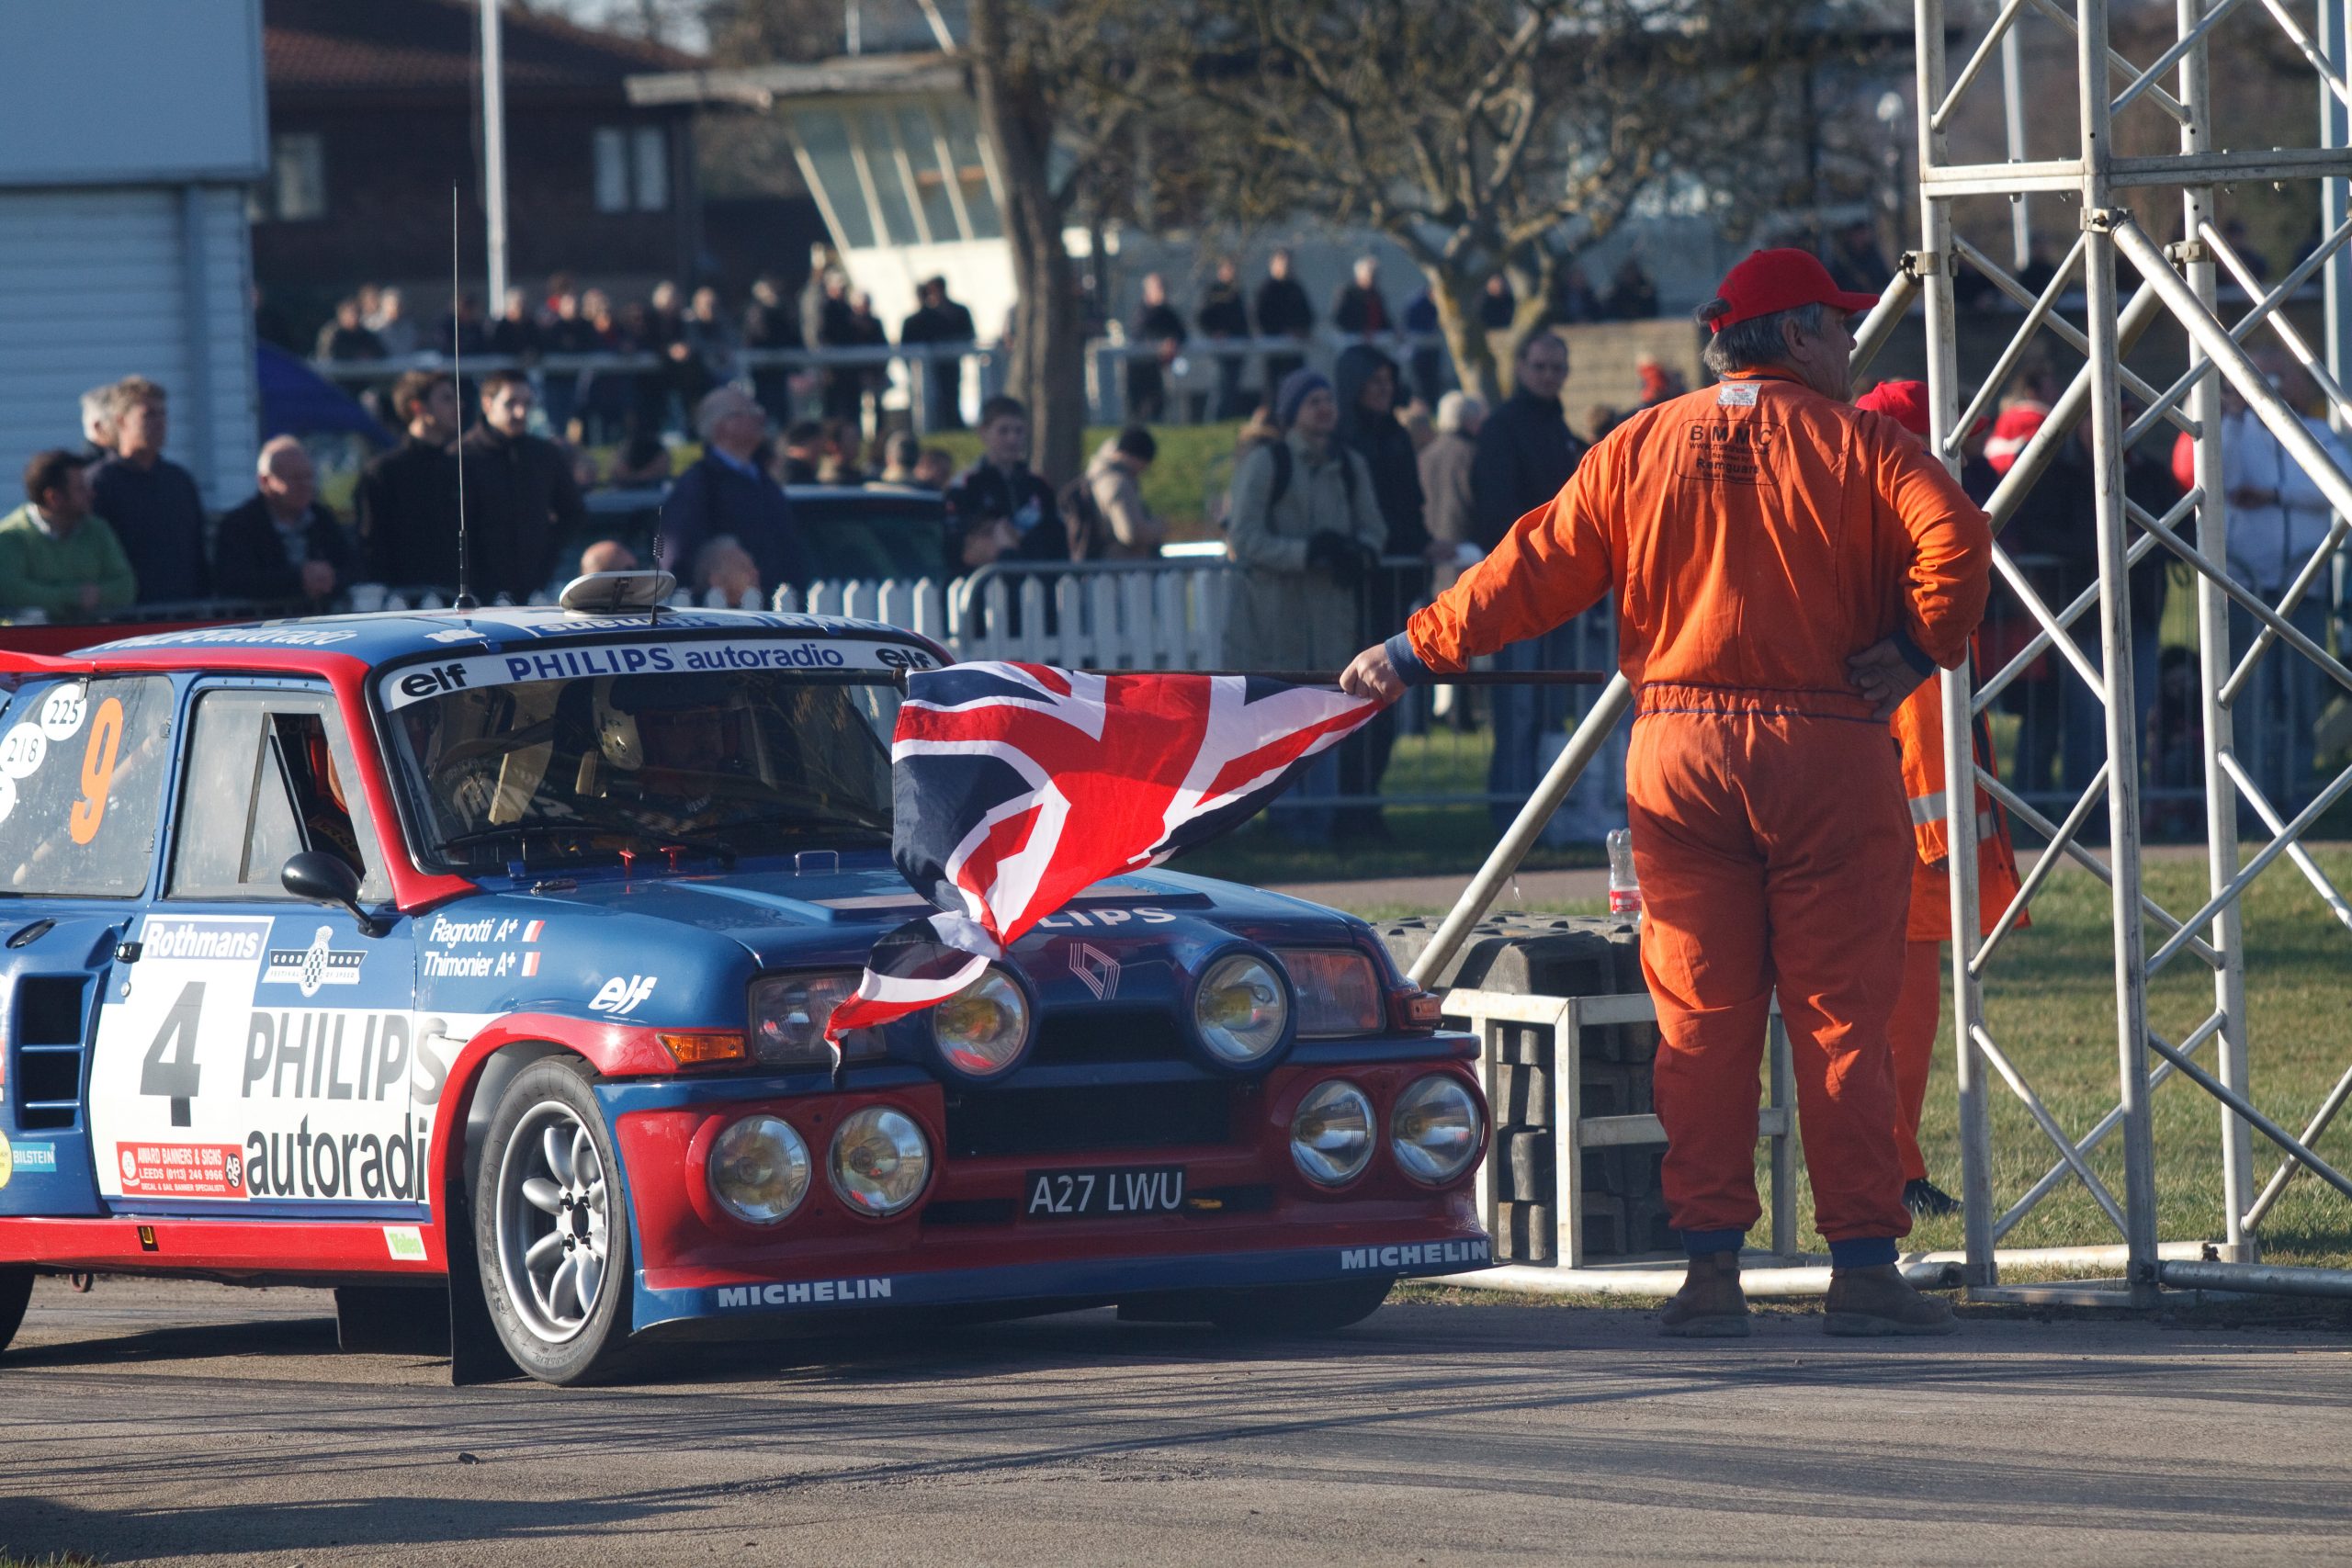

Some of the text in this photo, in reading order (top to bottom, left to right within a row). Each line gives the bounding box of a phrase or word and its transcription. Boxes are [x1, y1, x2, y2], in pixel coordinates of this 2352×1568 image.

[401, 643, 934, 696] elf PHILIPS autoradio elf
[49, 699, 81, 725] 225
[7, 738, 39, 762] 218
[70, 697, 123, 845] 9
[144, 922, 260, 959] Rothmans
[429, 917, 495, 949] Ragnotti
[273, 953, 360, 965] GOOD WOOD
[424, 952, 493, 976] Thimonier
[588, 975, 657, 1014] elf
[140, 981, 207, 1127] 4
[242, 1011, 449, 1106] PHILIPS
[13, 1149, 55, 1164] BILSTEIN
[138, 1147, 221, 1166] AWARD BANNERS & SIGNS
[247, 1112, 433, 1201] autoradi
[139, 1168, 223, 1182] LEEDS (0113) 246 9966
[1028, 1171, 1182, 1213] A27 LWU
[1341, 1241, 1488, 1269] MICHELIN
[718, 1278, 891, 1308] MICHELIN
